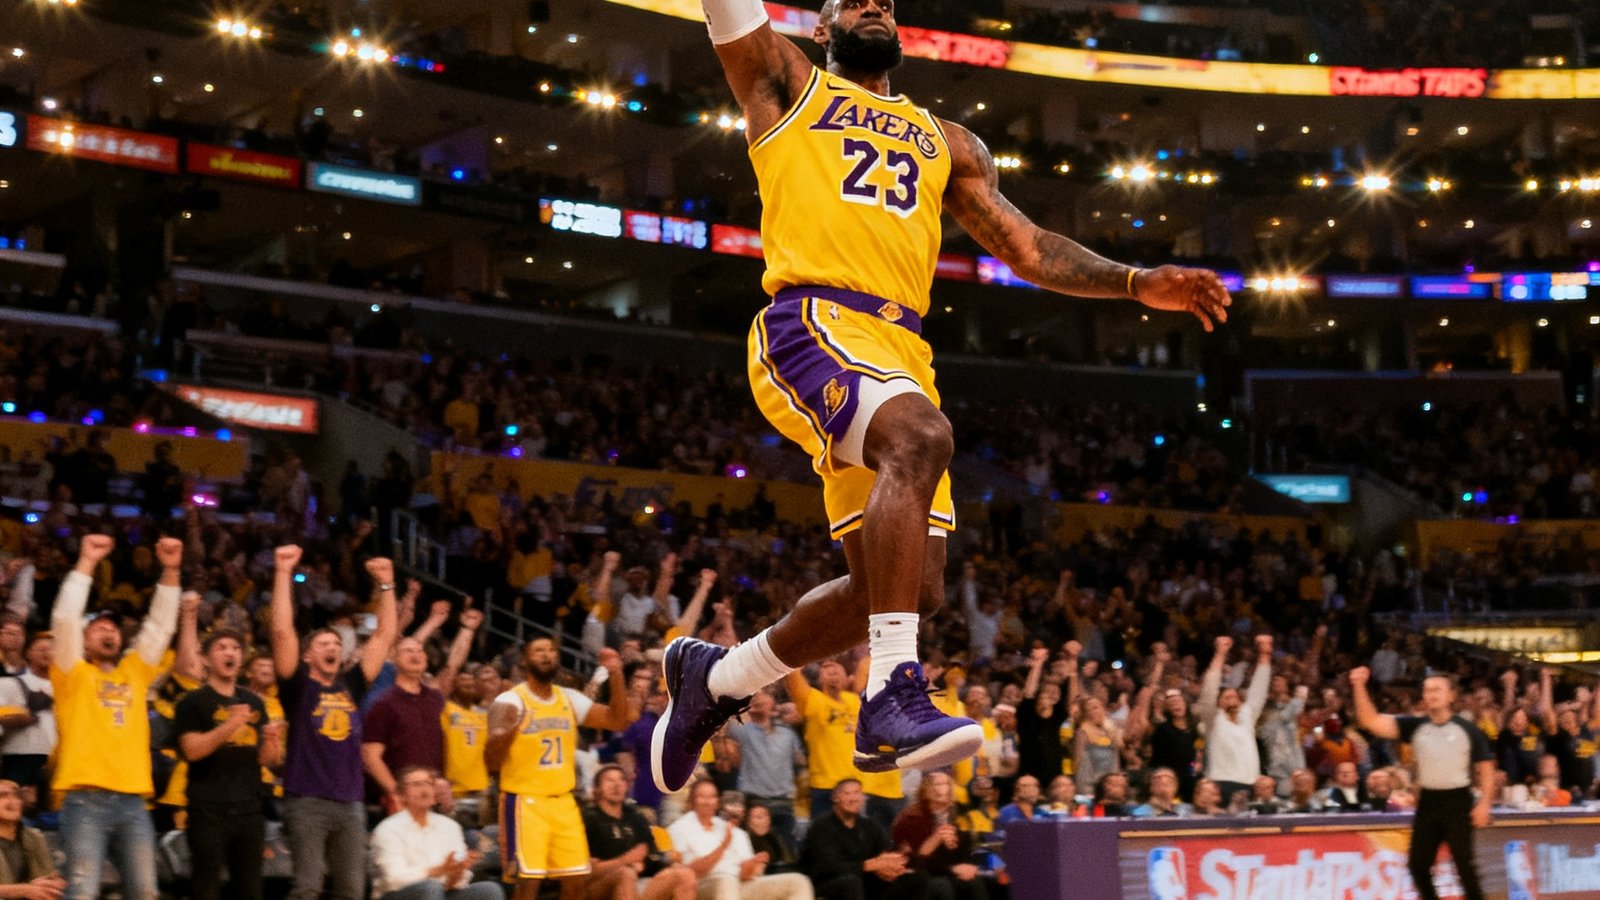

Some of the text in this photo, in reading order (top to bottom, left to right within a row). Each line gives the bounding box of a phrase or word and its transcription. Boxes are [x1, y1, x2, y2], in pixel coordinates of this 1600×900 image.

[808, 95, 940, 159] LAKERS
[841, 137, 920, 217] 23
[539, 736, 562, 767] 21
